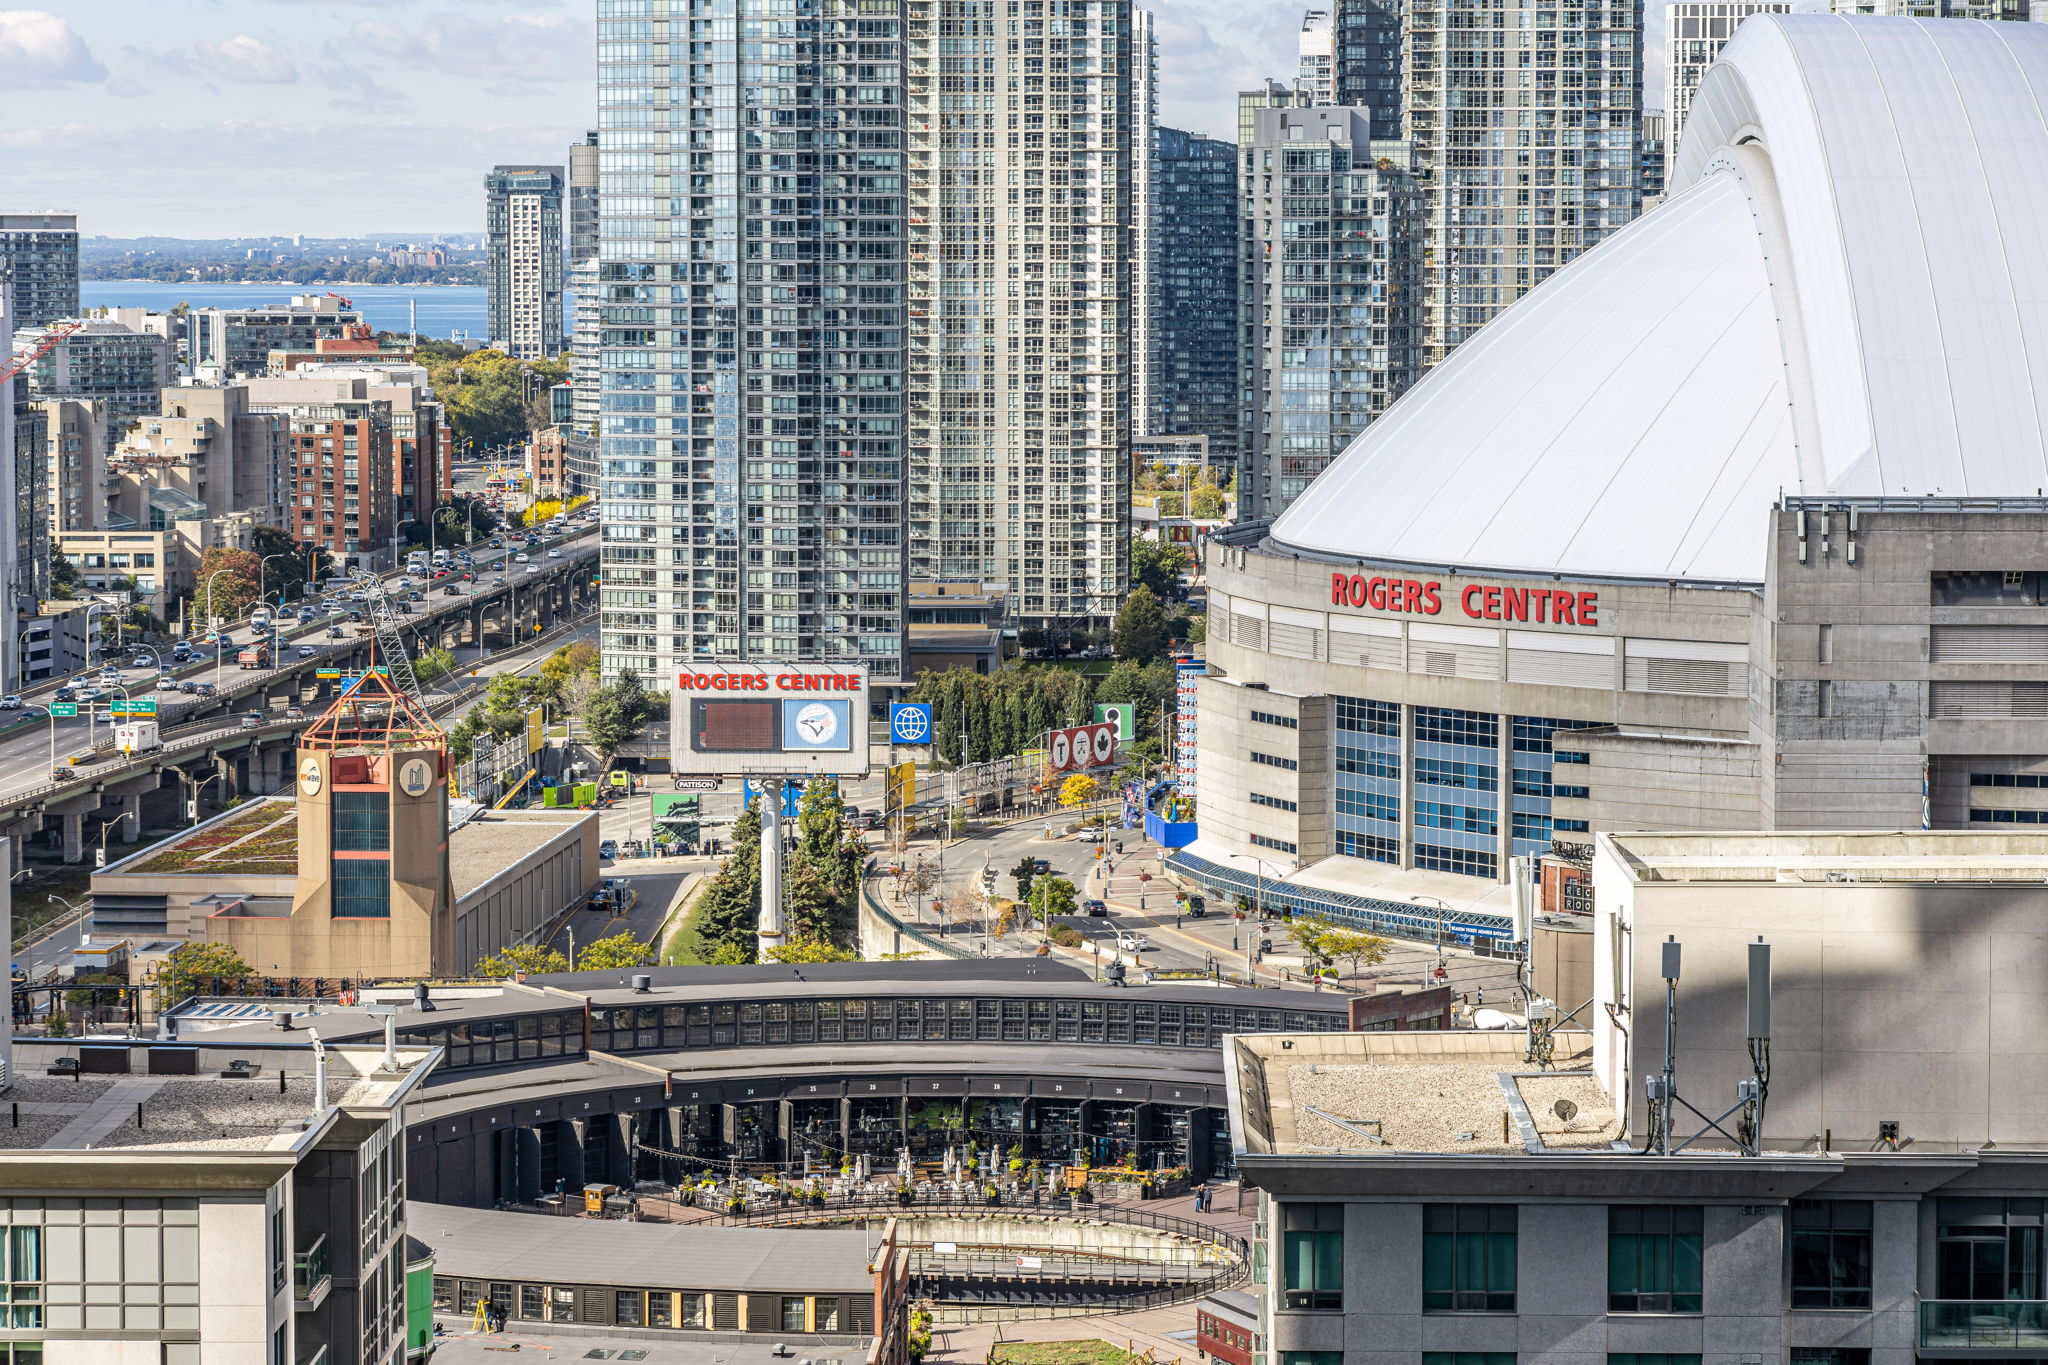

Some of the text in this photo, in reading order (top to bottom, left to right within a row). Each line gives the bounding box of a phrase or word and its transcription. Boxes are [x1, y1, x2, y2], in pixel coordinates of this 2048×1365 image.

[1331, 573, 1598, 626] ROGERS CENTRE
[679, 673, 861, 691] ROGERS CENTRE
[1566, 886, 1591, 897] REC
[1566, 900, 1591, 910] ROO
